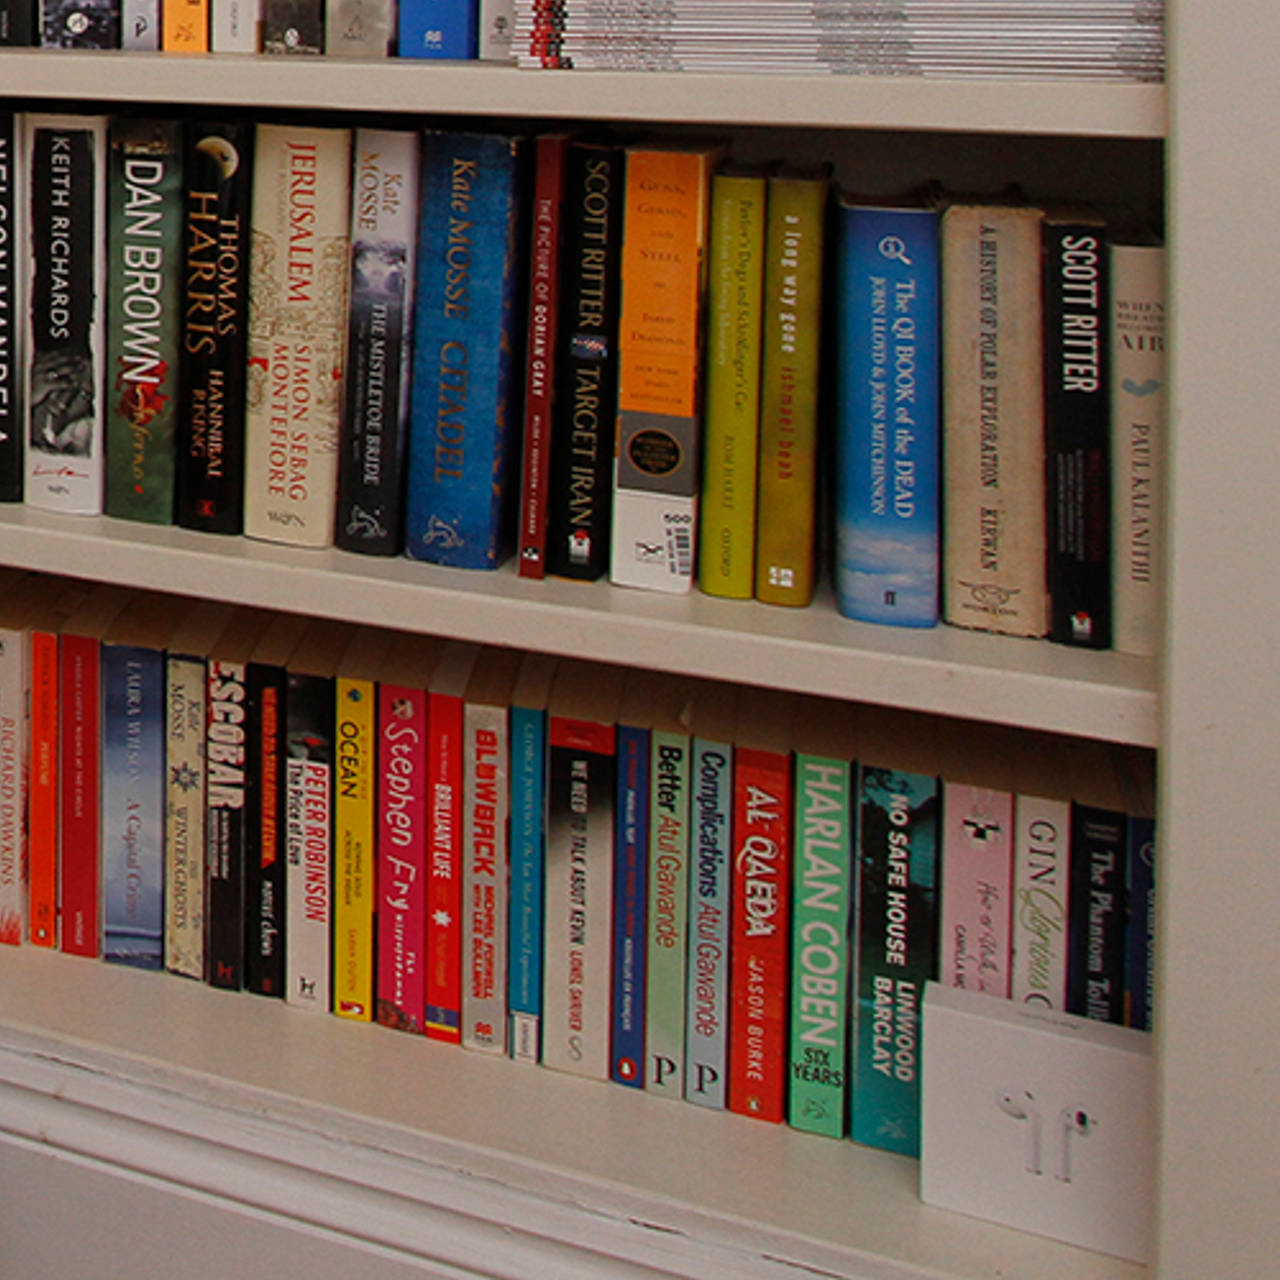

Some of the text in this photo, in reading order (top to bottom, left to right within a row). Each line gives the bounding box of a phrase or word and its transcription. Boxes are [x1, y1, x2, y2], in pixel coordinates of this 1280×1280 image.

[51, 136, 71, 340] KEITH RICHARDS
[286, 142, 316, 303] JERUSALEM
[359, 151, 380, 231] MOSSE
[122, 160, 163, 383] DAN BROWN
[186, 190, 219, 356] HARRIS
[217, 214, 239, 337] THOMAS
[434, 158, 477, 485] Kate MOSSE CITADEL
[567, 160, 609, 526] SCOTT RITTER TARGET IRAN
[870, 276, 887, 314] JOHN
[871, 317, 887, 365] LLOYD
[1061, 235, 1100, 394] SCOTT RITTER
[268, 341, 289, 496] MONTEFIORE
[289, 343, 311, 502] SIMON SEBAG
[870, 381, 887, 419] JOHN
[871, 423, 886, 516] MITCHINSON
[890, 279, 916, 518] The QI BOOK of the DEAD
[980, 224, 998, 572] A HISTORY OF POLAR EXPLORATION KIRWAN
[1131, 422, 1152, 584] PAUL KALANITHI
[1, 717, 16, 886] RICHARD DAWKINS
[207, 661, 245, 811] ESCOBAR
[340, 720, 360, 799] OCEAN
[472, 729, 498, 876] BLOWBACK
[305, 764, 327, 923] PETER ROBINSON
[384, 721, 419, 912] Stephen Fry
[654, 744, 683, 949] Better Atul Gawande
[694, 750, 727, 1038] Complications Atul Gawande
[885, 793, 911, 966] NO SAFE HOUSE
[1027, 820, 1057, 886] GIN
[800, 762, 844, 1048] HARLAN COBEN
[1086, 850, 1114, 973] The Phantom
[746, 960, 765, 1020] JASON
[746, 1025, 765, 1081] BURKE
[872, 974, 893, 1076] BARCLAY
[894, 979, 916, 1082] LINWOOD
